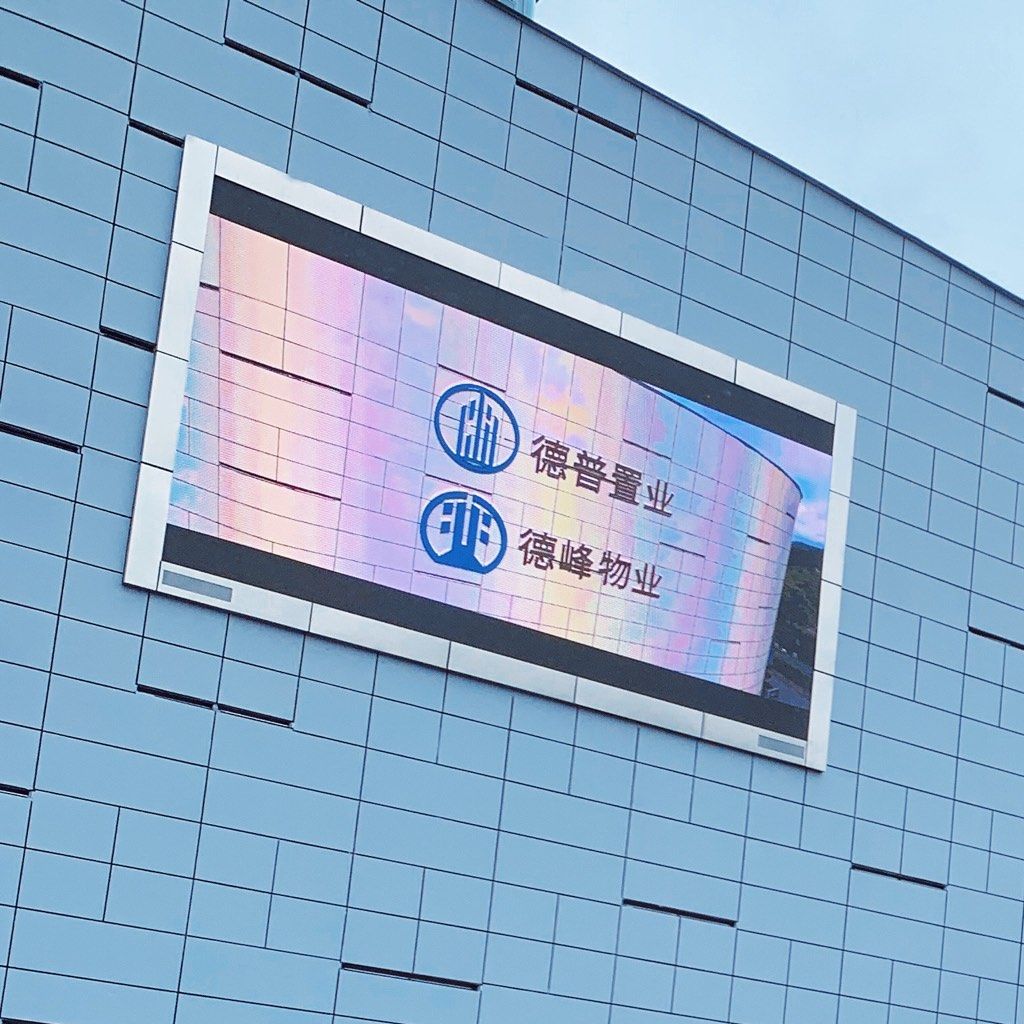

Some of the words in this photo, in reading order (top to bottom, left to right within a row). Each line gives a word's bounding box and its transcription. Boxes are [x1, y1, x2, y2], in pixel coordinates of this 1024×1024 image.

[530, 435, 674, 518] 德普置业
[518, 528, 662, 598] 德峰物业
